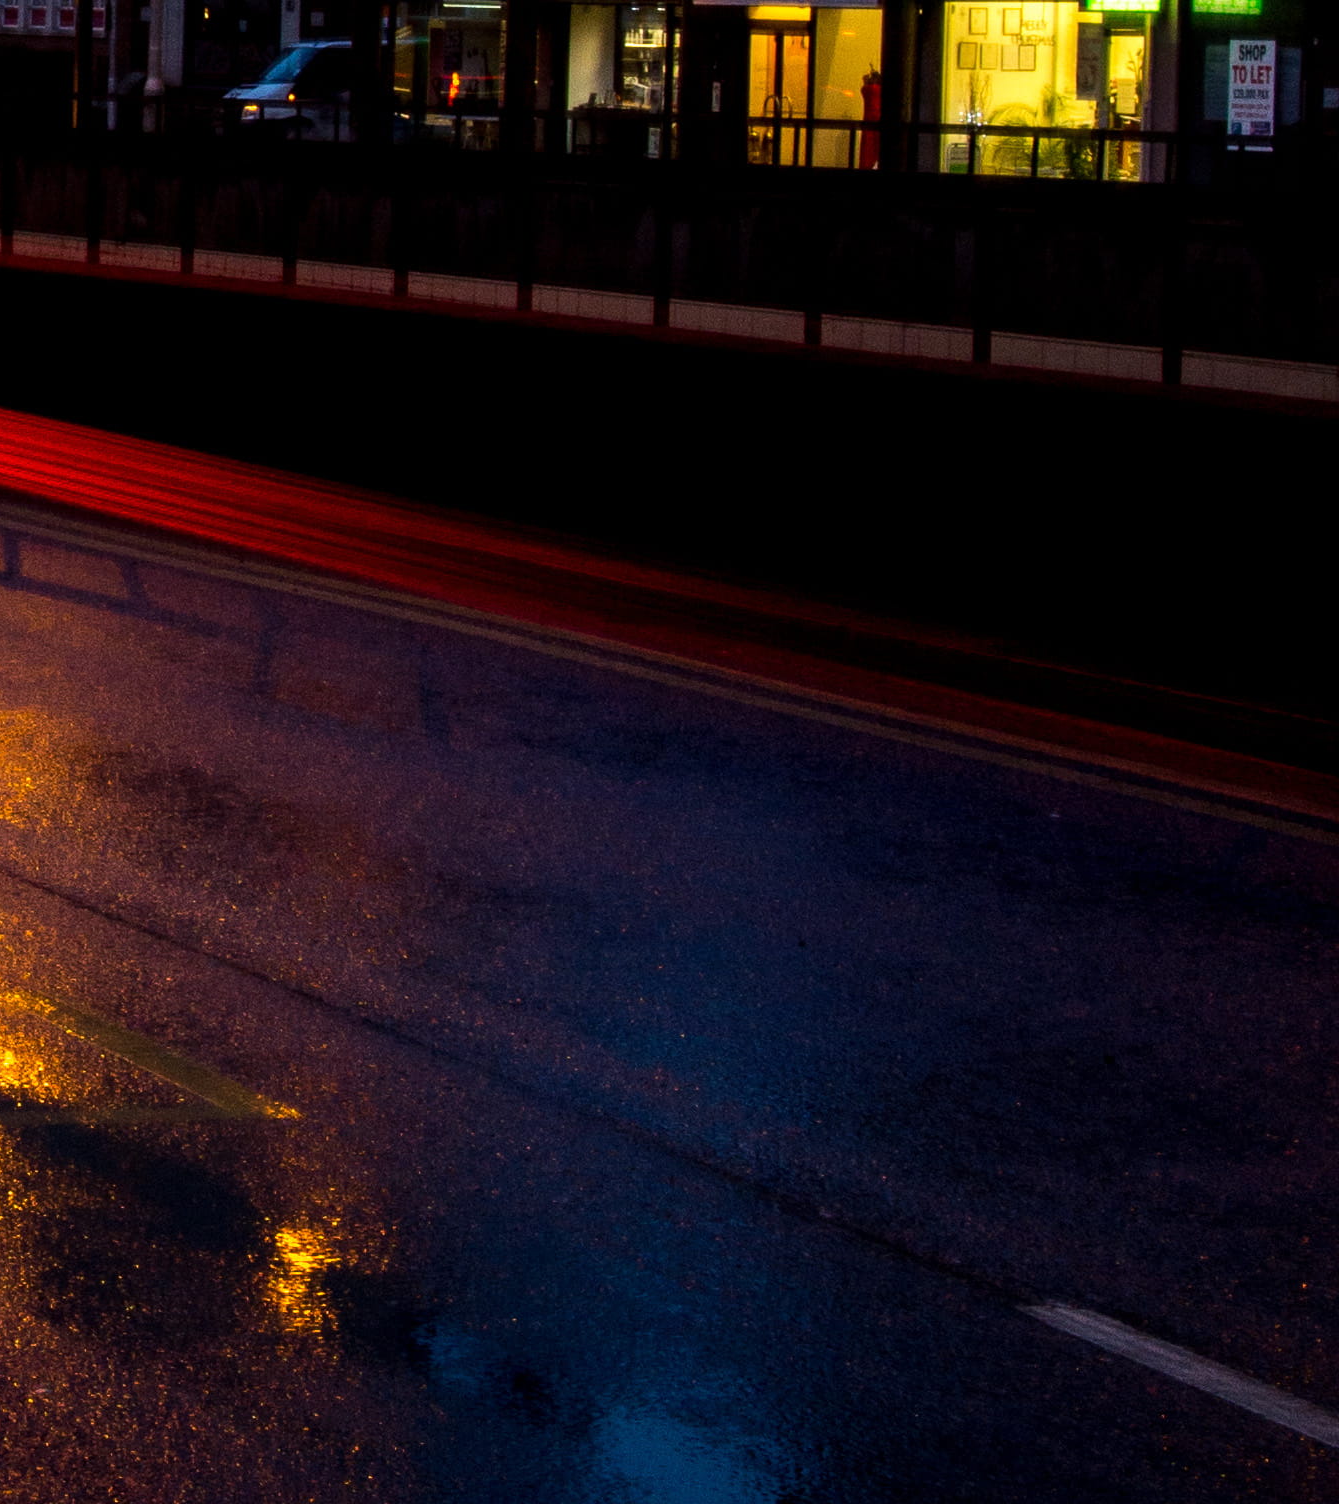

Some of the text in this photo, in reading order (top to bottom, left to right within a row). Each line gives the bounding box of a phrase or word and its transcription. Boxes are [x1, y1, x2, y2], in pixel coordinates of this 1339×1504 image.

[1239, 44, 1267, 61] SHOP
[1232, 65, 1272, 84] TO LET
